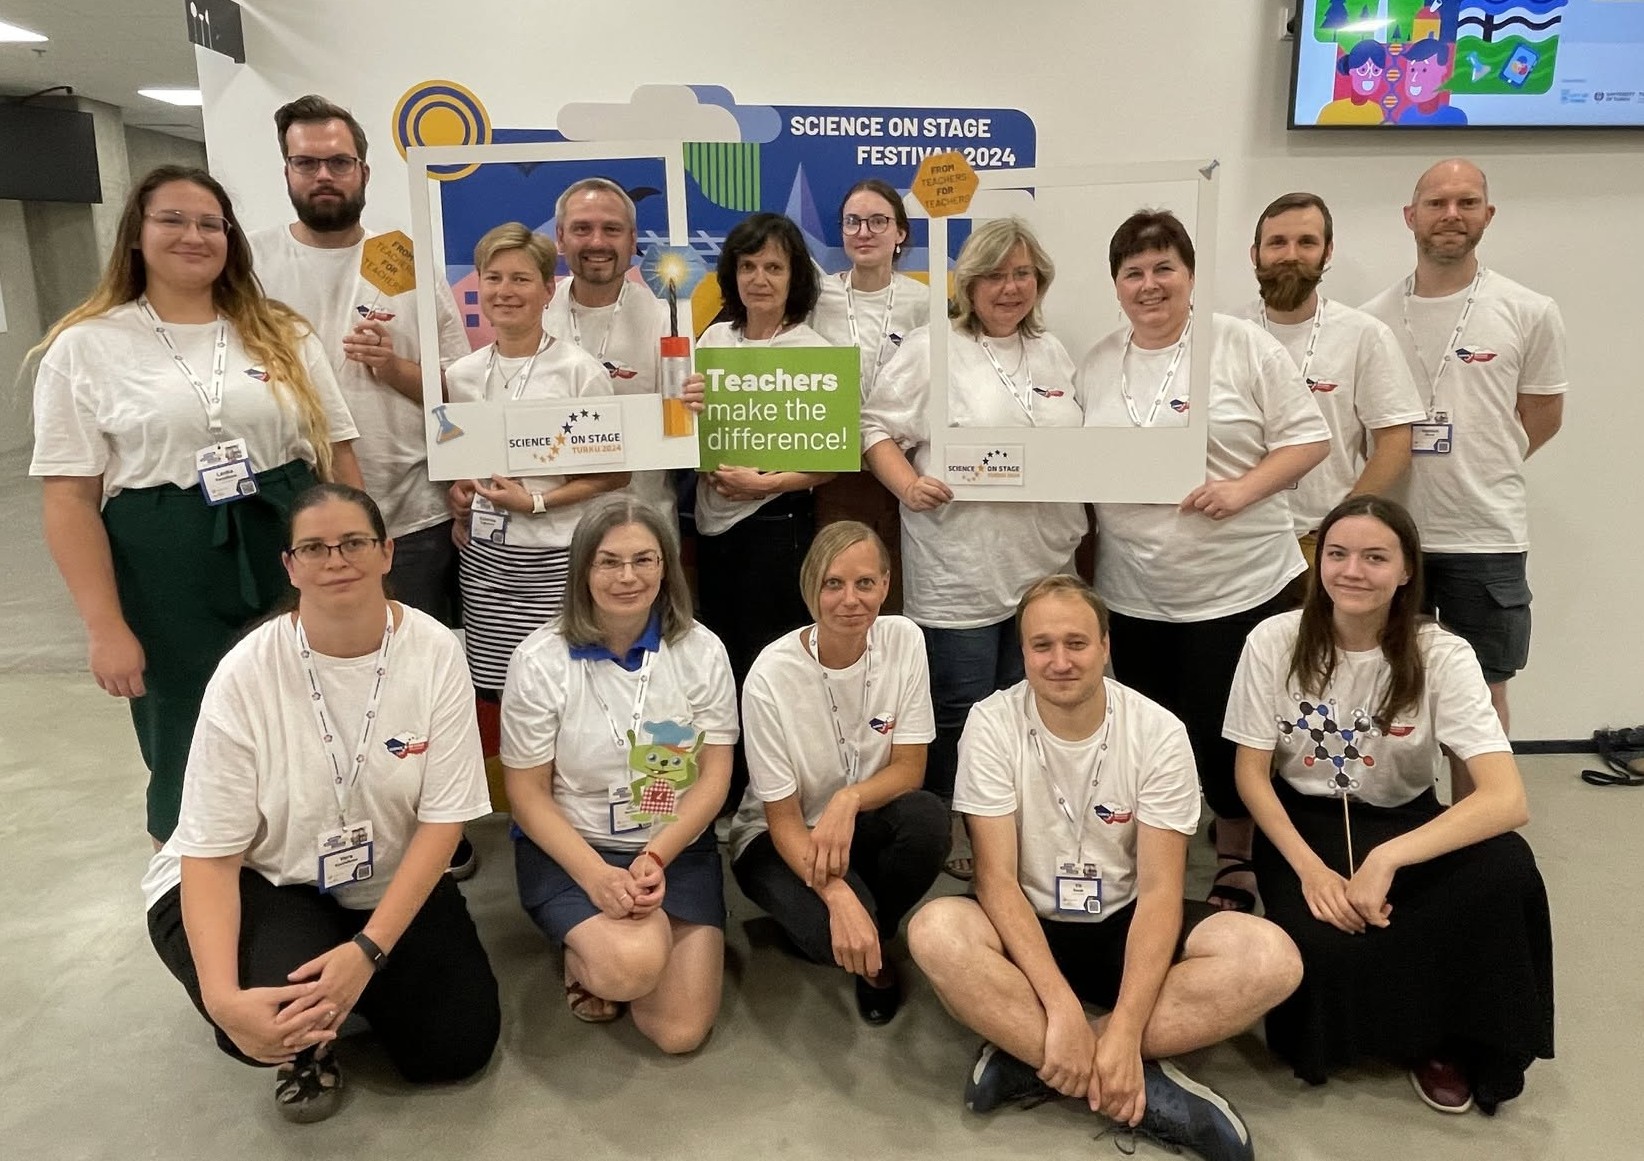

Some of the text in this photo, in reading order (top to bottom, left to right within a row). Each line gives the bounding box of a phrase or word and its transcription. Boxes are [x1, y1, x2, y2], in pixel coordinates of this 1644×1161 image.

[790, 116, 992, 138] SCIENCE ON STAGE
[857, 146, 1016, 167] FESTIVA 2024
[930, 164, 955, 175] FROM
[921, 173, 967, 187] TEACHERS
[936, 186, 954, 196] FOR
[924, 194, 971, 209] TEACHERS
[391, 241, 414, 261] FROM
[381, 259, 398, 275] FOR
[706, 368, 838, 392] Teachers
[707, 398, 826, 421] make the
[509, 432, 621, 448] SCIENCE ON STAGE
[707, 427, 847, 450] difference!
